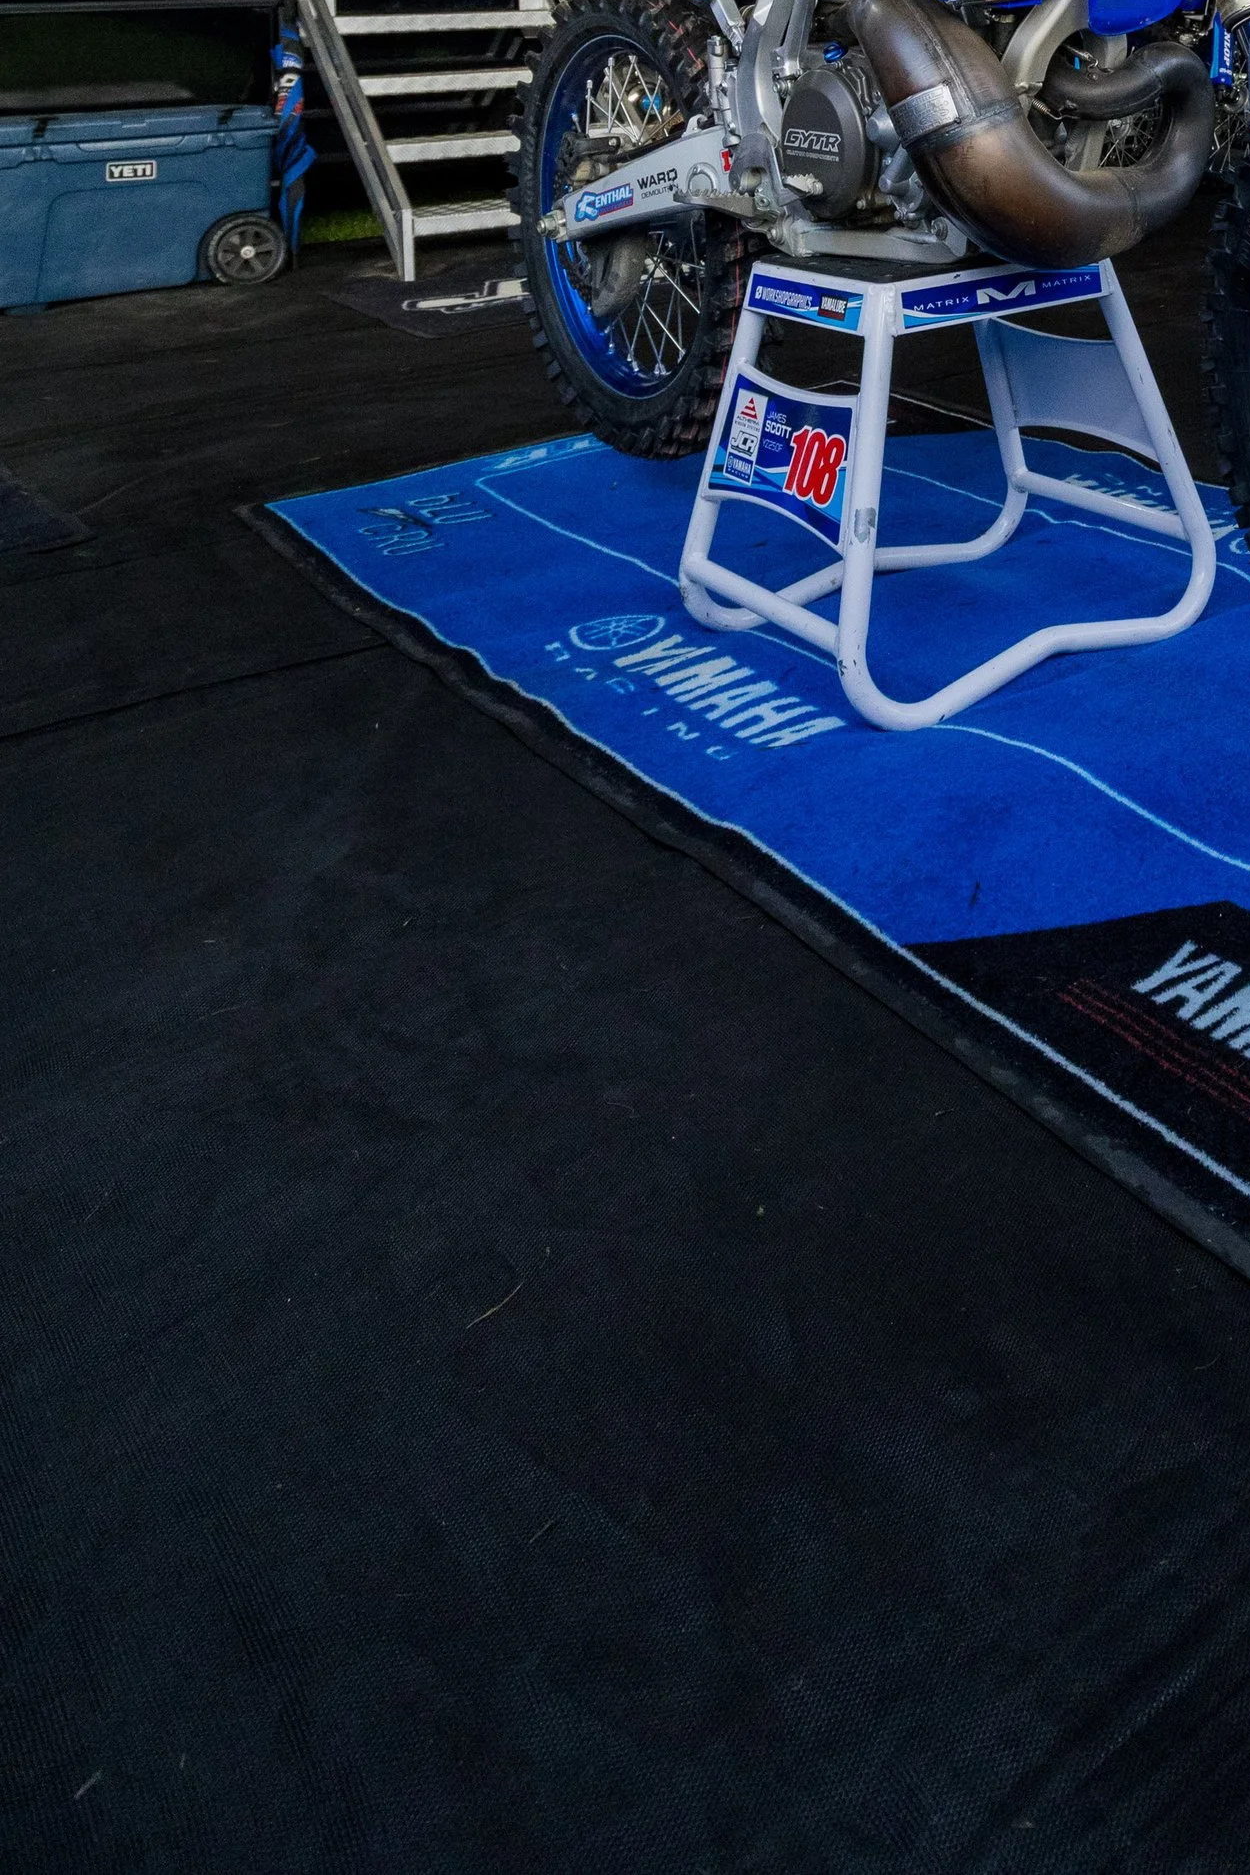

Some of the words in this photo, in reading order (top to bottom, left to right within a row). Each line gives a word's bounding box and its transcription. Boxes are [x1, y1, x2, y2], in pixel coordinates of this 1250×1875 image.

[1222, 27, 1236, 66] NLOP
[784, 128, 842, 153] GYTR
[109, 162, 152, 180] YETI
[637, 168, 679, 191] WARD
[576, 185, 633, 220] RENTHAL
[762, 288, 813, 311] WORKSHOPGRAPHICS
[821, 295, 847, 315] YAMALUBE
[913, 295, 970, 312] MATRIX
[1041, 274, 1092, 288] MATRIX
[764, 420, 792, 440] SCOTT
[766, 410, 787, 424] JAMES
[731, 430, 759, 453] JCR
[782, 425, 846, 507] 108
[357, 524, 445, 556] CRU
[614, 633, 847, 748] YAMAHA
